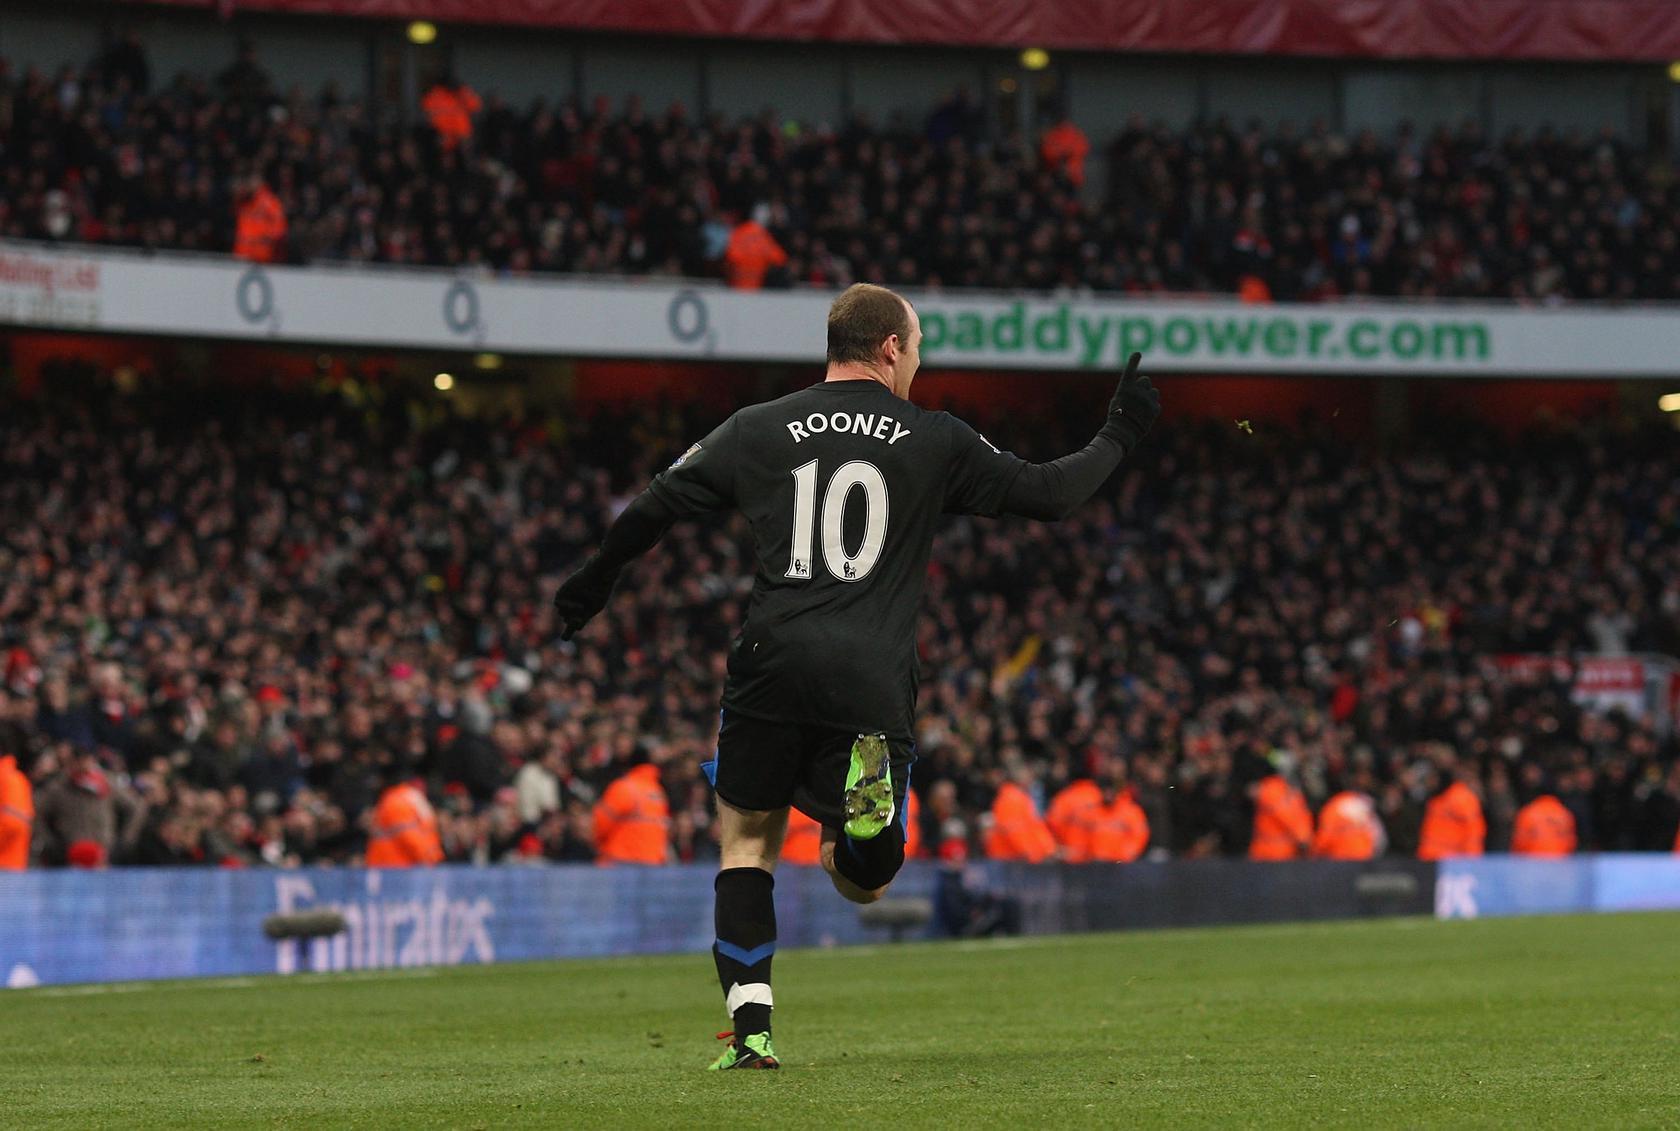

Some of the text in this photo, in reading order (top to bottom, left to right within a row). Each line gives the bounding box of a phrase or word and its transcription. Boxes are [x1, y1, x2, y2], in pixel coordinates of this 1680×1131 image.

[920, 299, 1490, 368] paddypower.com
[786, 412, 911, 445] ROONEY
[784, 458, 890, 582] 10
